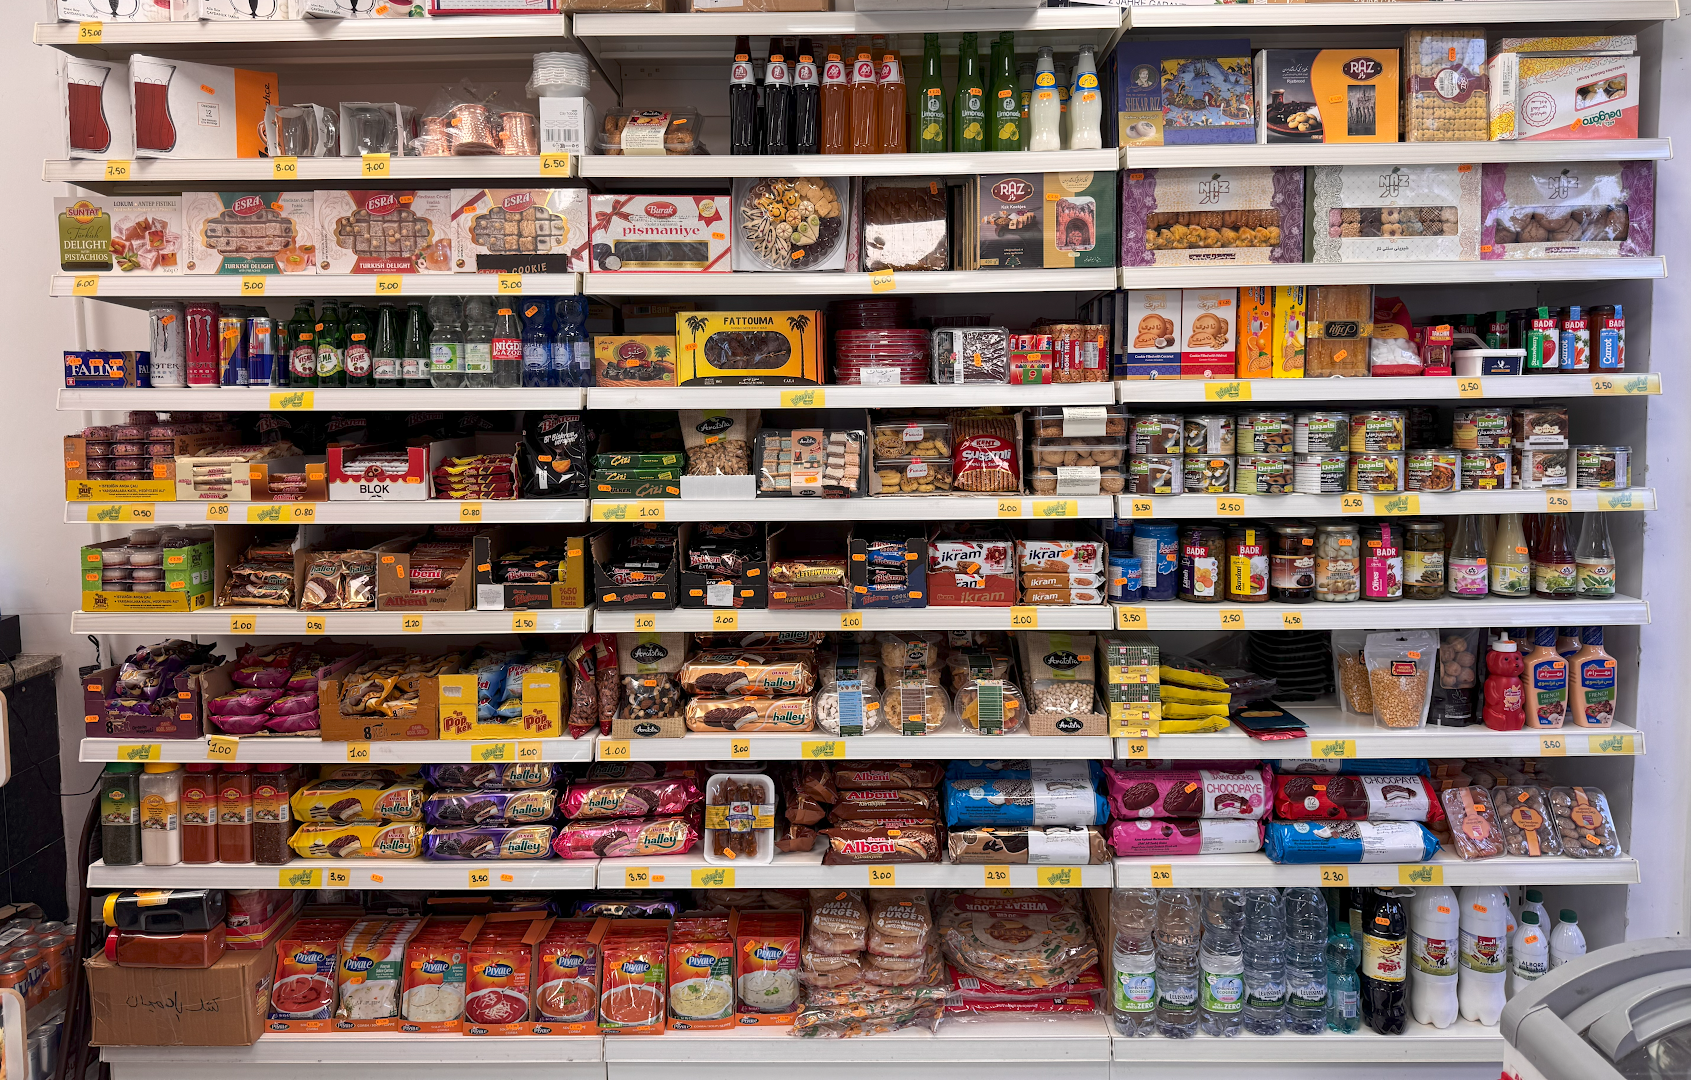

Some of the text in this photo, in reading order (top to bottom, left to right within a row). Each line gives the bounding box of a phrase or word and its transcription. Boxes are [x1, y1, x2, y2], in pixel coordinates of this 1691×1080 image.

[82, 28, 101, 37] 35.00
[1351, 61, 1374, 72] RAZ
[276, 164, 294, 172] 8.00
[366, 162, 384, 172] 7.00
[544, 159, 564, 168] 6.50
[108, 167, 125, 175] 7.50
[1199, 180, 1230, 194] NAZ
[1379, 175, 1410, 188] NAZ
[1548, 176, 1579, 189] NAZ
[1000, 182, 1025, 195] RAZ
[235, 197, 260, 211] ESRA
[368, 195, 395, 209] ESRA
[504, 192, 531, 207] ESRA
[648, 205, 674, 216] Burak
[622, 224, 700, 238] pişmaniye
[64, 240, 107, 250] DELIGHT
[64, 253, 109, 262] PISTACHIOS
[512, 263, 547, 275] COOKIE
[501, 280, 521, 288] 5.00
[874, 275, 891, 285] 6.00
[380, 282, 398, 290] 5.00
[723, 316, 774, 326] FATTOUMA
[1533, 319, 1555, 329] BADR
[1564, 321, 1585, 330] BADR
[1530, 335, 1539, 367] Strawberry
[1602, 338, 1613, 365] Carrot
[1461, 383, 1478, 391] 2.50
[976, 439, 998, 447] KENT
[360, 484, 390, 494] BLOK
[635, 482, 664, 497] Çizi
[1344, 499, 1362, 507] 2.50
[1550, 497, 1568, 505] 2.50
[210, 506, 228, 514] 0.80
[641, 508, 658, 516] 1.00
[1000, 504, 1016, 512] 2.00
[941, 549, 982, 562] ikram
[1186, 546, 1205, 555] BADR
[1239, 546, 1260, 555] BADR
[1376, 547, 1396, 556] BADR
[310, 564, 338, 577] halley
[1031, 577, 1057, 587] ikram
[1235, 565, 1243, 592] Bandari
[1372, 571, 1380, 592] Olives
[383, 595, 428, 607] Albeni
[960, 590, 1005, 604] ikram
[1032, 592, 1058, 602] ikram
[516, 619, 533, 627] 1.50
[637, 619, 653, 627] 1.00
[843, 618, 859, 626] 1.00
[1123, 614, 1140, 622] 3.50
[233, 621, 251, 629] 1.00
[763, 678, 797, 690] halley
[1540, 691, 1560, 699] FRENCH
[772, 710, 806, 724] halley
[443, 716, 467, 732] Pop
[454, 721, 473, 735] kek
[524, 715, 548, 731] Pop
[535, 719, 553, 733] kek
[208, 741, 231, 754] 1.00
[350, 748, 367, 757] 1.00
[521, 748, 537, 756] 1.00
[605, 747, 626, 755] 1.00
[734, 745, 748, 753] 3.00
[509, 770, 542, 784] halley
[852, 771, 891, 782] Albeni
[1364, 775, 1420, 786] CHOCOPAYE
[1207, 782, 1263, 795] CHOCOPAYE
[846, 789, 899, 801] Albeni
[380, 806, 412, 817] halley
[512, 805, 545, 817] halley
[644, 834, 677, 848] halley
[379, 842, 411, 854] halley
[508, 842, 540, 854] halley
[842, 841, 895, 855] Albeni
[331, 873, 345, 881] 3.50
[472, 874, 487, 883] 3.50
[629, 873, 646, 881] 3.50
[873, 871, 891, 880] 3.00
[987, 872, 1005, 880] 2.30
[1324, 872, 1343, 881] 2.30
[965, 901, 1049, 911] WHEAT FLOUR
[816, 908, 860, 920] BURGER
[879, 911, 925, 922] BURGER
[814, 915, 820, 925] 4
[877, 918, 885, 927] 4
[294, 951, 325, 964] Piyale
[755, 948, 783, 960] Piyale
[345, 959, 373, 970] Piyale
[422, 961, 448, 973] Piyale
[558, 956, 585, 968] Piyale
[687, 956, 717, 967] Piyale
[1521, 960, 1544, 968] ALBORZ
[485, 965, 513, 976] Piyale
[622, 962, 650, 973] Piyale
[1224, 1002, 1241, 1010] ZERO
